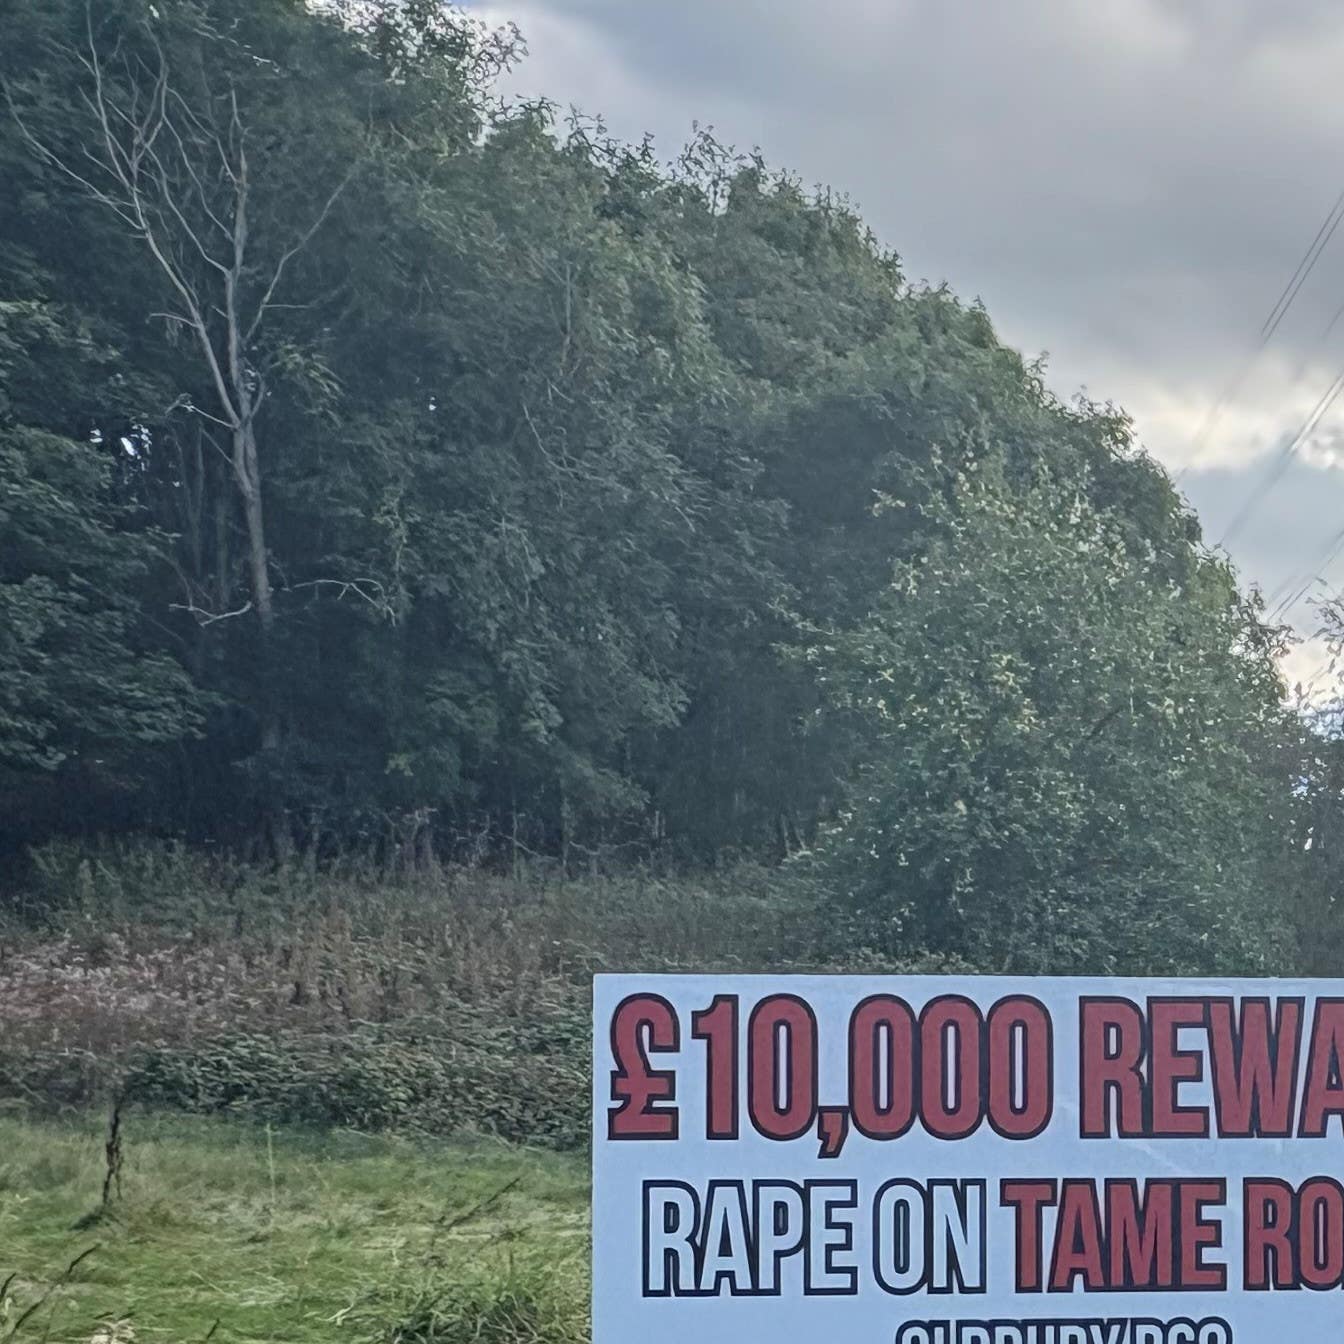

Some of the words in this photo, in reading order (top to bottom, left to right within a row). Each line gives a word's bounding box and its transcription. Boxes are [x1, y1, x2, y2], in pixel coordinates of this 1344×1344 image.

[607, 992, 1053, 1157] £10,000
[641, 1179, 858, 1297] RAPE
[872, 1178, 986, 1294] ON
[1000, 1177, 1227, 1293] TAME
